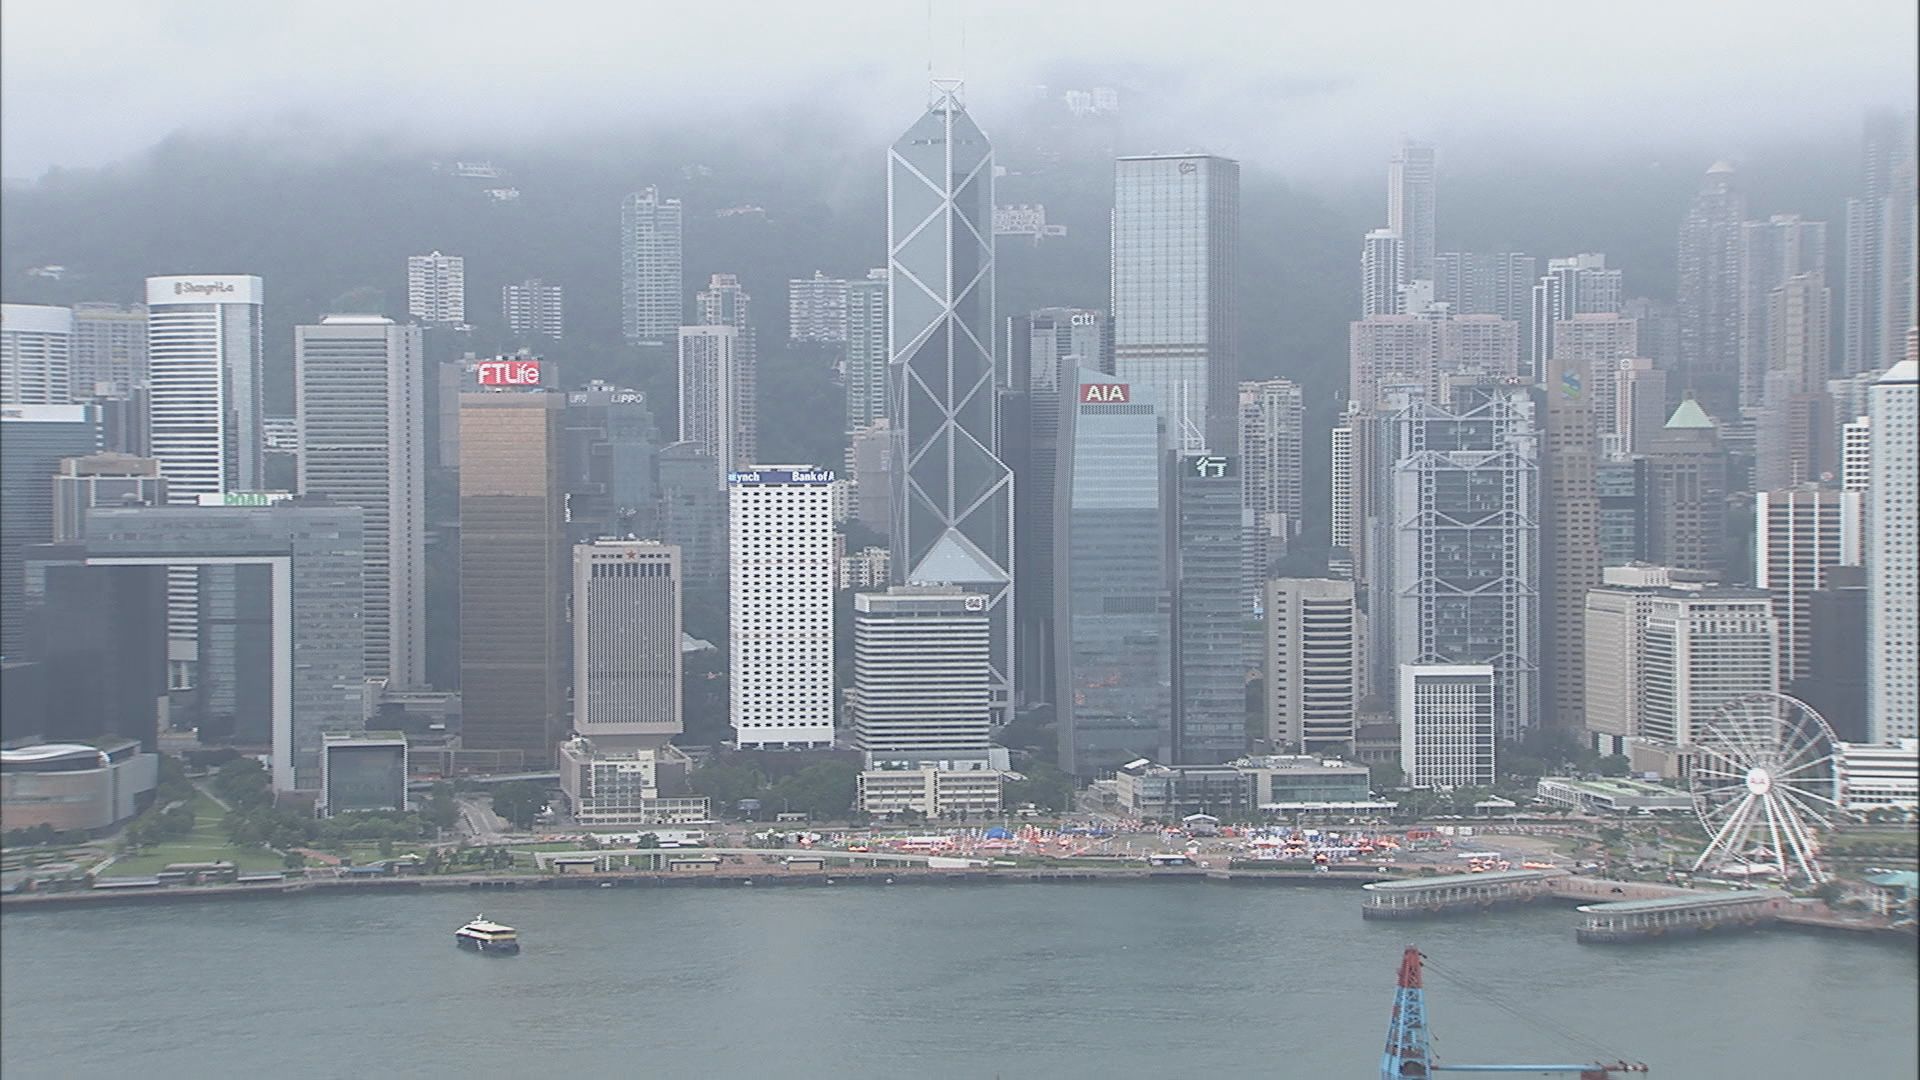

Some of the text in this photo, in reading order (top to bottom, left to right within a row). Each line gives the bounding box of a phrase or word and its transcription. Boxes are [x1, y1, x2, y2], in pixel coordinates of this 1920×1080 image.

[1071, 312, 1095, 326] citi
[478, 363, 539, 384] FTLife
[610, 393, 644, 404] LIPPO
[1086, 385, 1125, 401] AIA
[1195, 456, 1227, 477] 行
[791, 471, 816, 482] Bank
[817, 471, 828, 482] of
